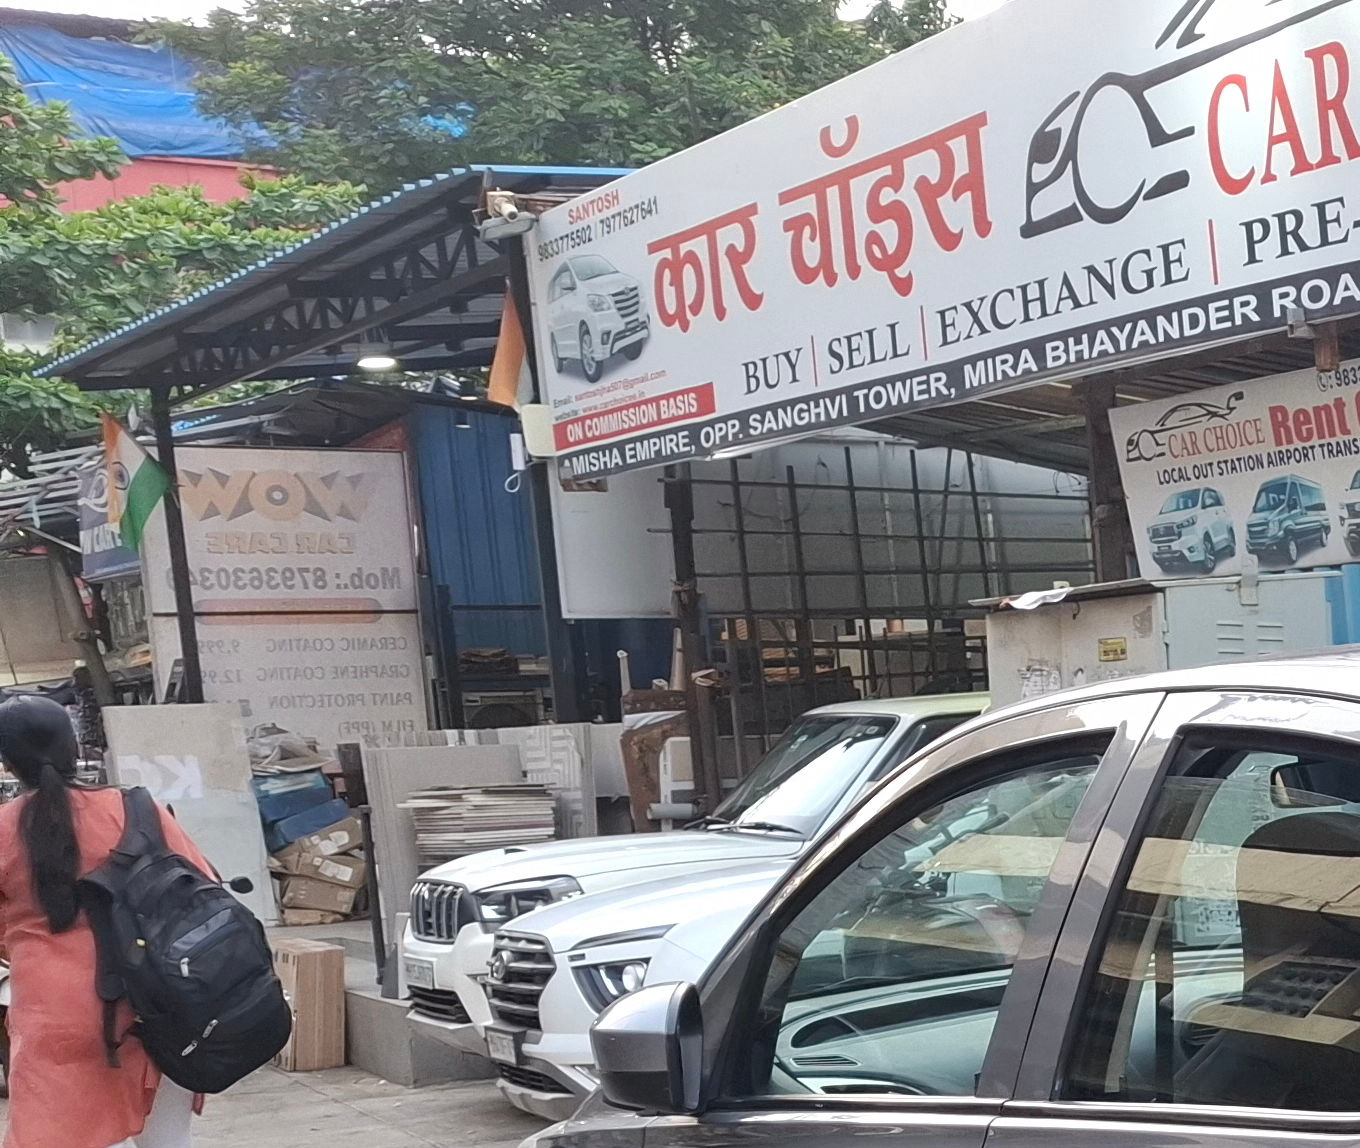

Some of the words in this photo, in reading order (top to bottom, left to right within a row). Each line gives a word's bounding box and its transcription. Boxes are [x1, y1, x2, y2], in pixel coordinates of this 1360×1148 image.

[538, 225, 593, 262] 9833775502
[600, 196, 659, 237] 7977627641
[568, 189, 619, 225] SANTOSH
[647, 202, 764, 333] कार
[778, 111, 993, 298] चॉइस
[743, 346, 804, 395] BUY
[827, 321, 911, 374] SELL
[936, 238, 1190, 347] EXCHANGE
[625, 431, 696, 463] EMPIRE,
[700, 419, 743, 448] OPP.
[749, 394, 848, 438] SANGHVI
[858, 371, 956, 413] TOWER,
[963, 349, 1037, 390] MIRA
[1045, 295, 1260, 369] BHAYANDER
[566, 419, 582, 443] ON
[584, 402, 658, 438] COMMISSION
[660, 392, 698, 423] BASIS
[1168, 432, 1201, 460] CAR
[1203, 418, 1266, 454] CHOICE
[1268, 397, 1351, 447] Rent
[1156, 464, 1191, 486] LOCAL
[1192, 461, 1215, 480] OUT
[1217, 455, 1265, 478] STATION
[1267, 444, 1317, 470] AIRPORT
